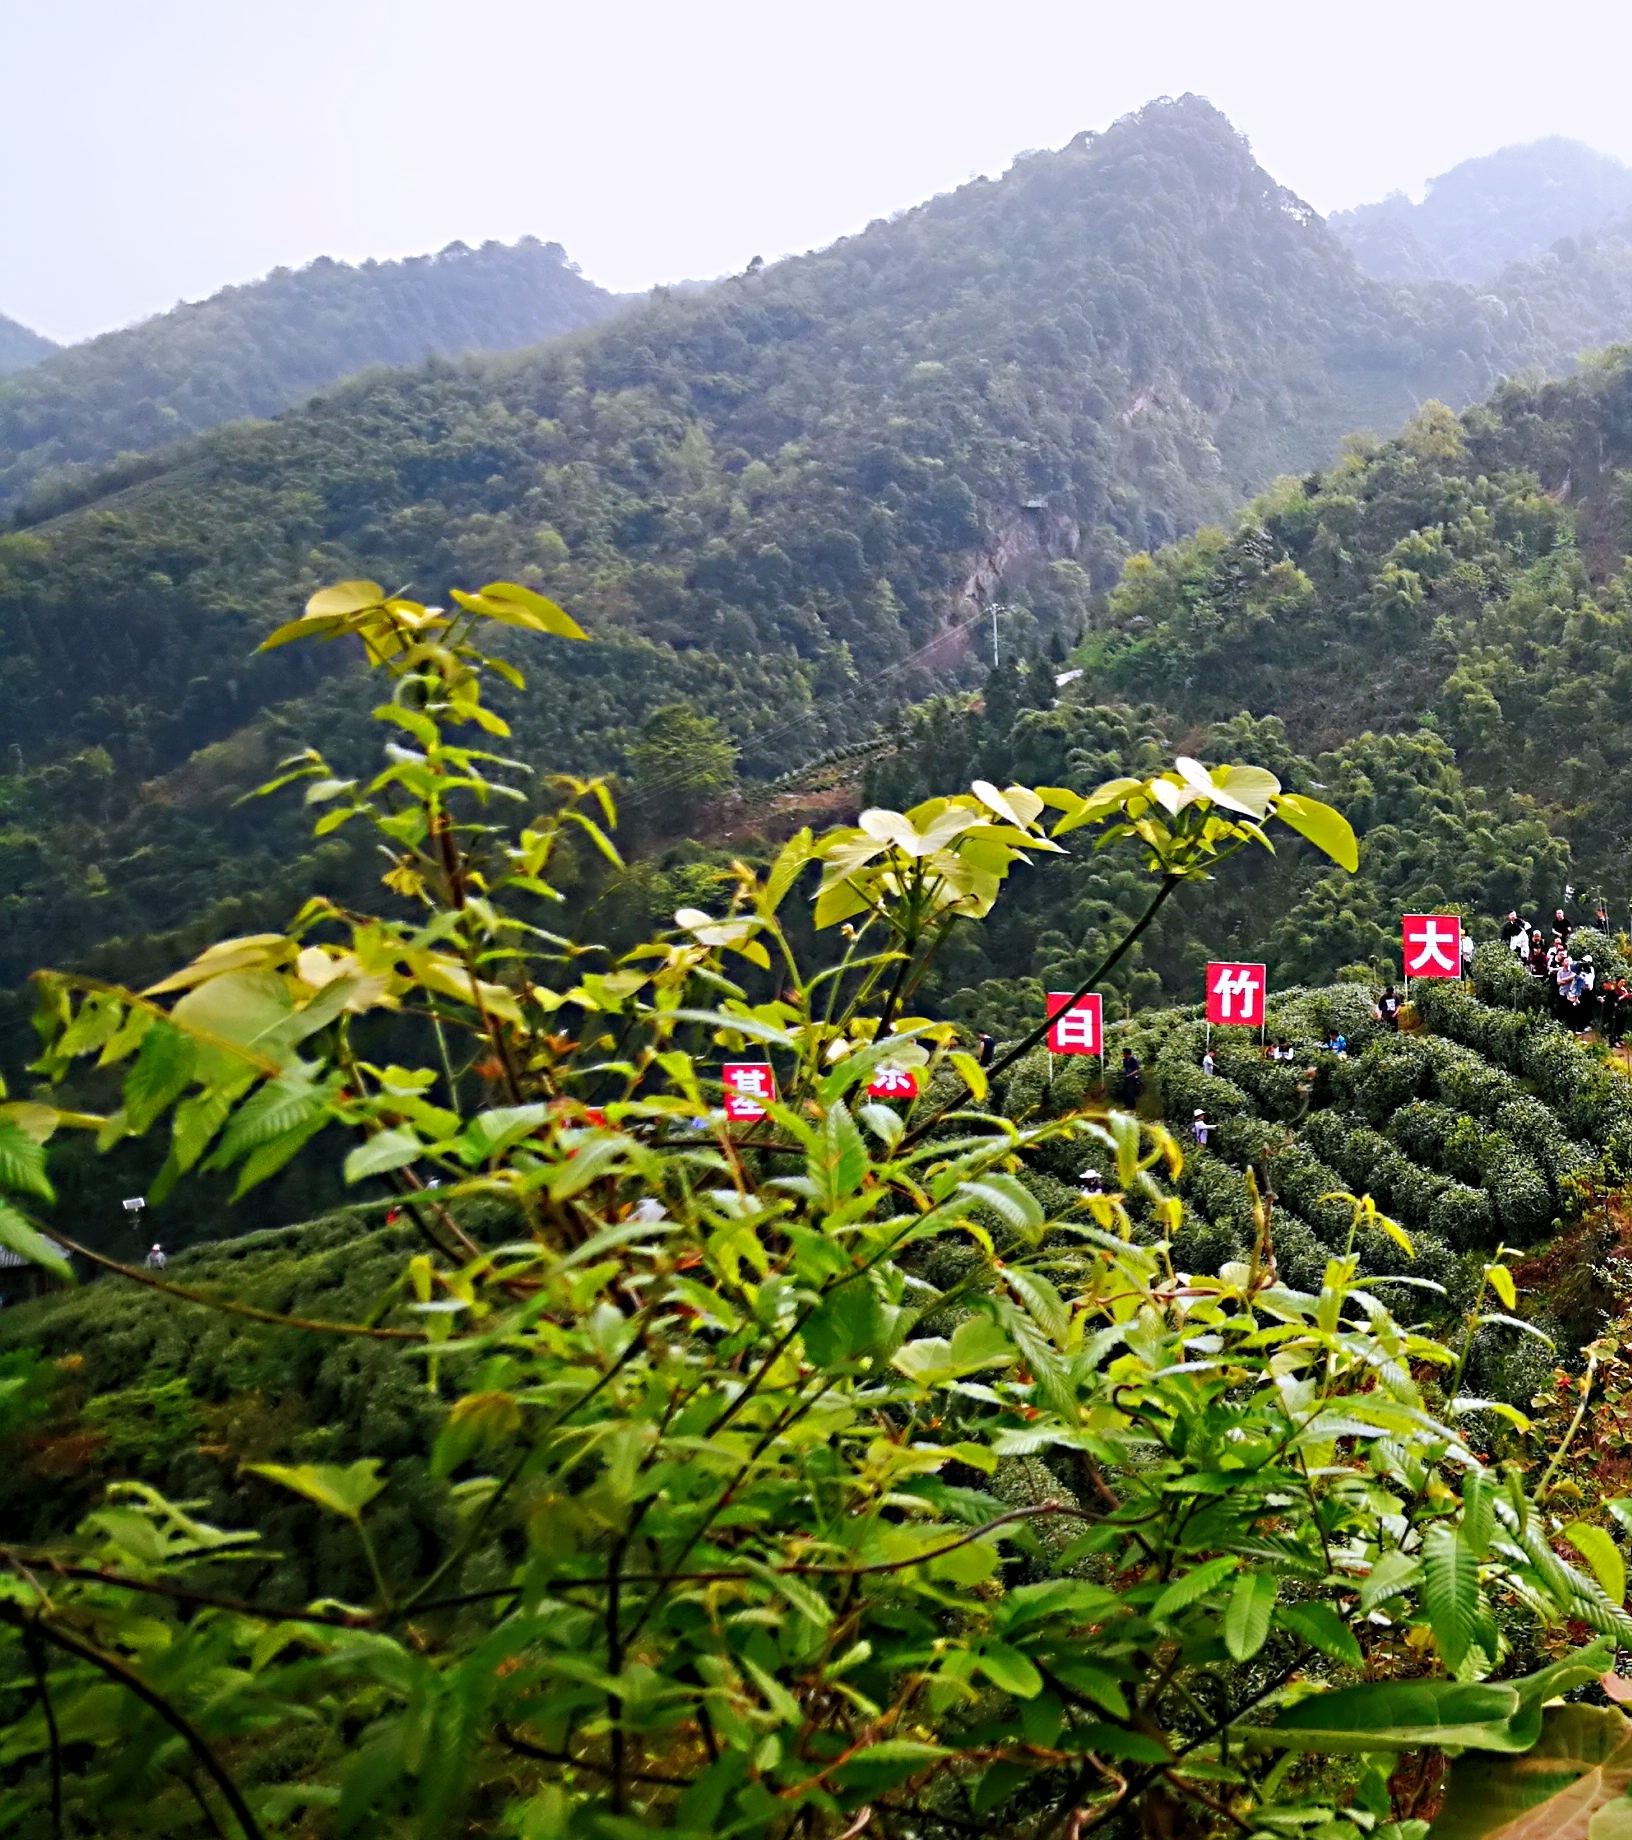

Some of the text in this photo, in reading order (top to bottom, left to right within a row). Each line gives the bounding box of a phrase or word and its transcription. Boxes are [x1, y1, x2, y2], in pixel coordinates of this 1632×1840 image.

[1409, 921, 1454, 971] 大
[1213, 969, 1260, 1018] 竹
[731, 1069, 769, 1115] 基
